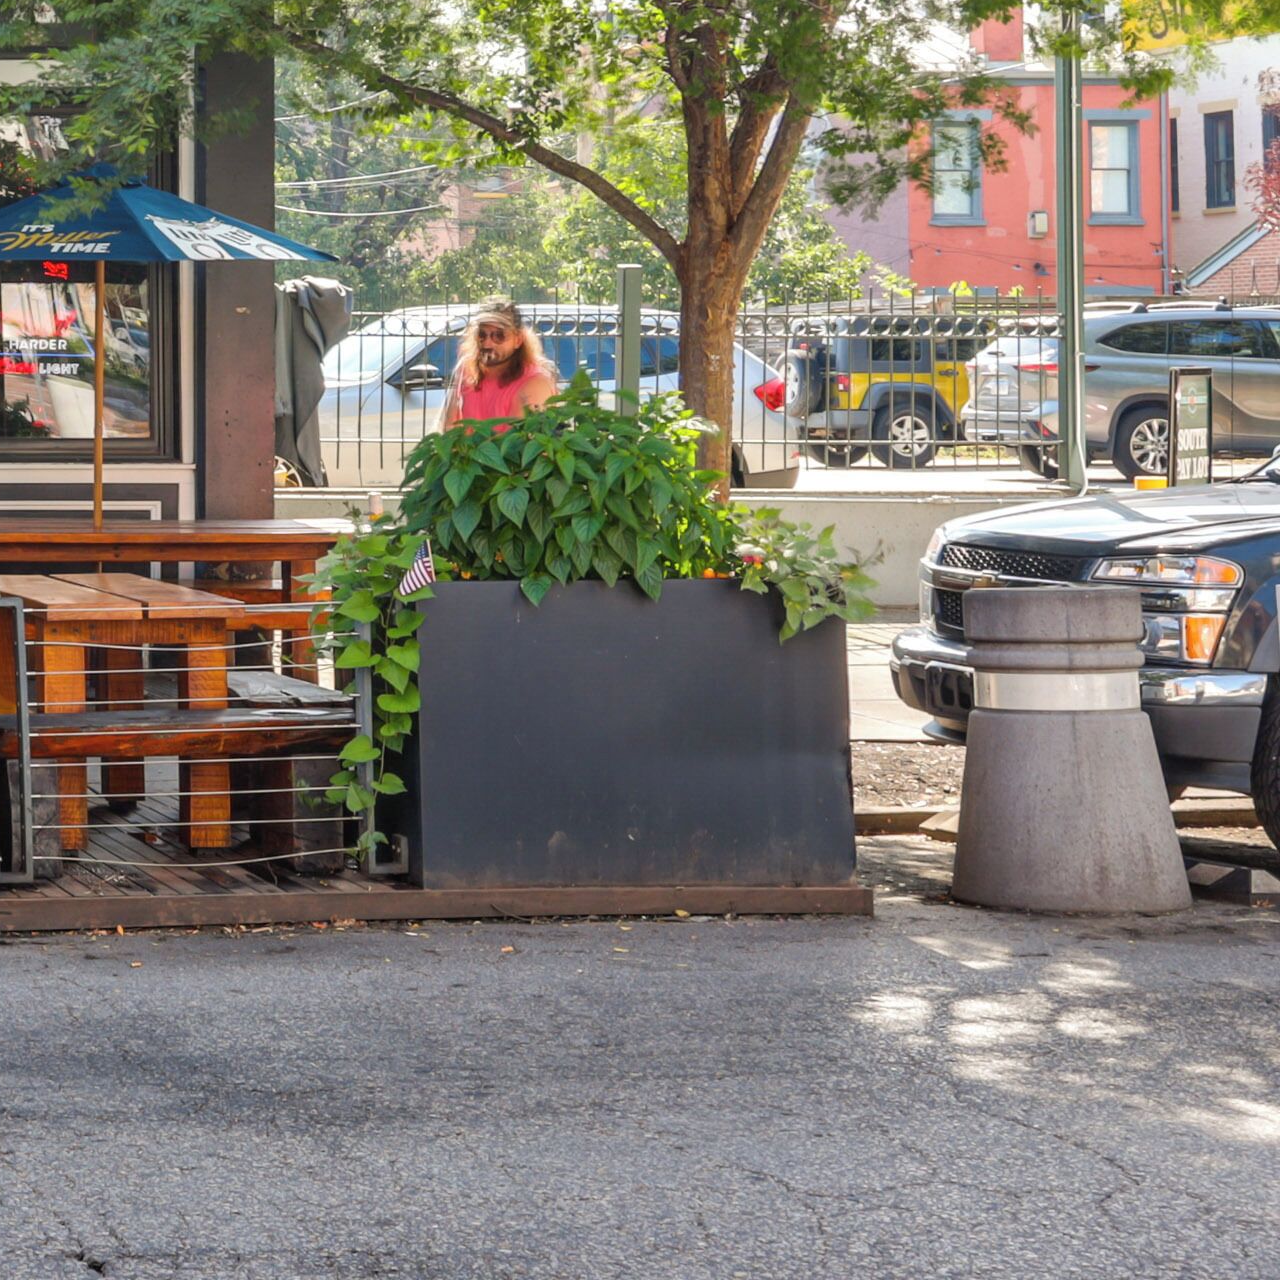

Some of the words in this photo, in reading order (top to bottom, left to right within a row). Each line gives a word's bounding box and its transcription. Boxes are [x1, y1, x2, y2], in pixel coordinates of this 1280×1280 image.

[20, 224, 55, 234] IT'S
[50, 242, 111, 254] TIME
[8, 339, 68, 350] HARDER
[39, 363, 80, 375] LIGHT
[1177, 428, 1208, 452] SOUTH
